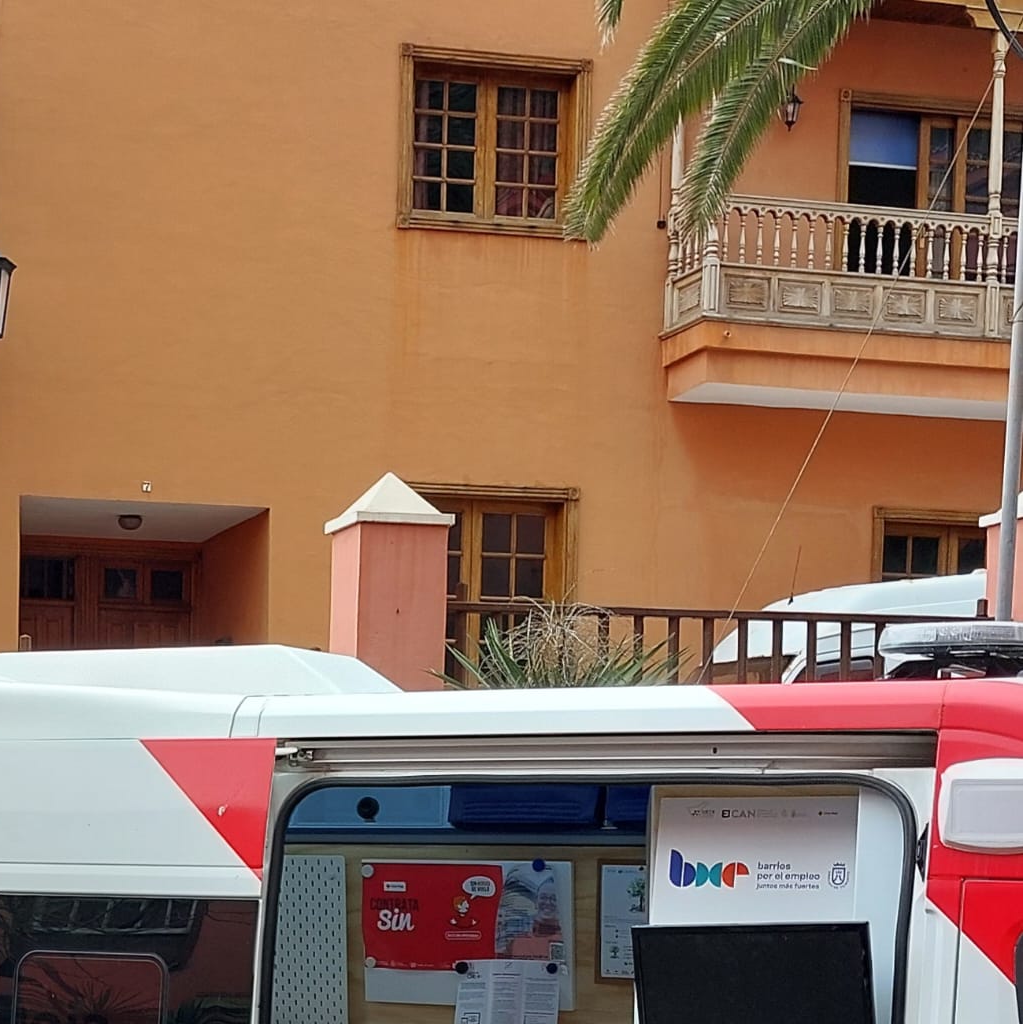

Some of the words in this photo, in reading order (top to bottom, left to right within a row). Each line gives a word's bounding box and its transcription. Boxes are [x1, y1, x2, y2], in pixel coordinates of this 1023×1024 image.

[757, 860, 791, 870] barrios
[757, 873, 773, 881] por
[774, 871, 783, 880] el
[785, 872, 821, 881] empleo
